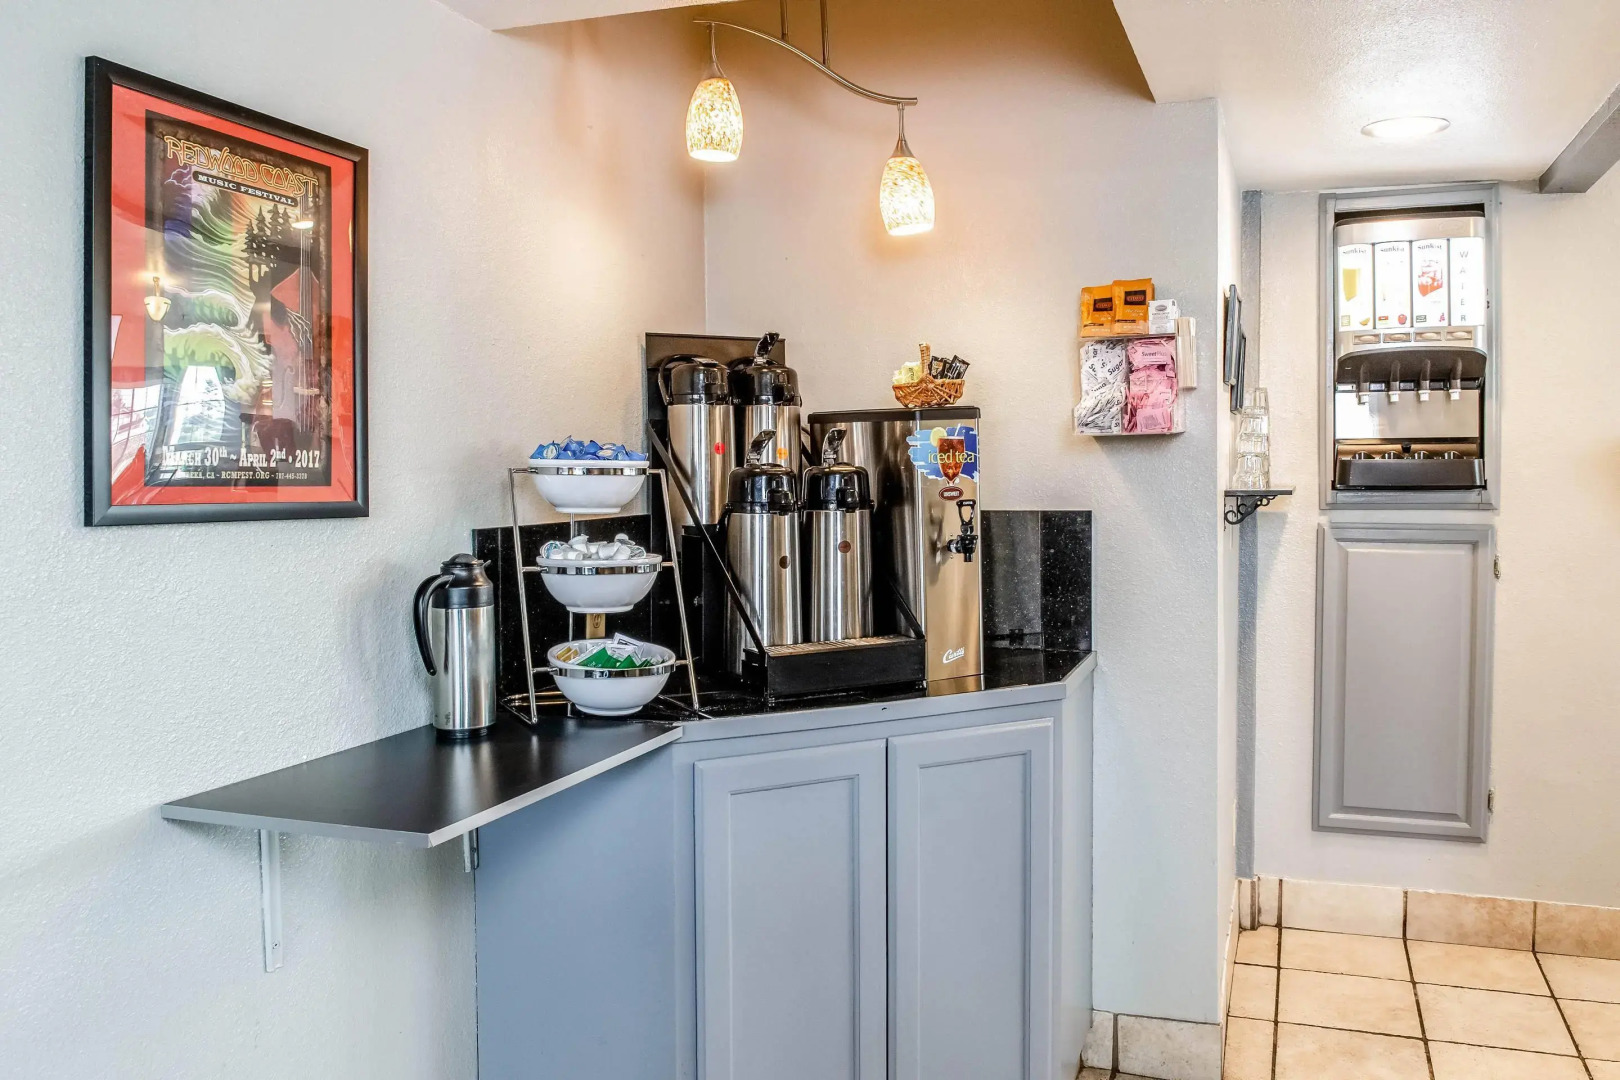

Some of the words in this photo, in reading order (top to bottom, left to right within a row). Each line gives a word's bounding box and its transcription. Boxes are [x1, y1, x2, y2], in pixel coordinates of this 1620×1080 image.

[164, 136, 258, 182] REDWOOD
[260, 164, 318, 198] COAST
[198, 174, 237, 190] MUSIC
[240, 185, 295, 205] FESTIVAL
[239, 448, 268, 467] APRIL
[295, 449, 320, 468] 2017
[928, 449, 953, 464] iced
[955, 450, 974, 463] tea
